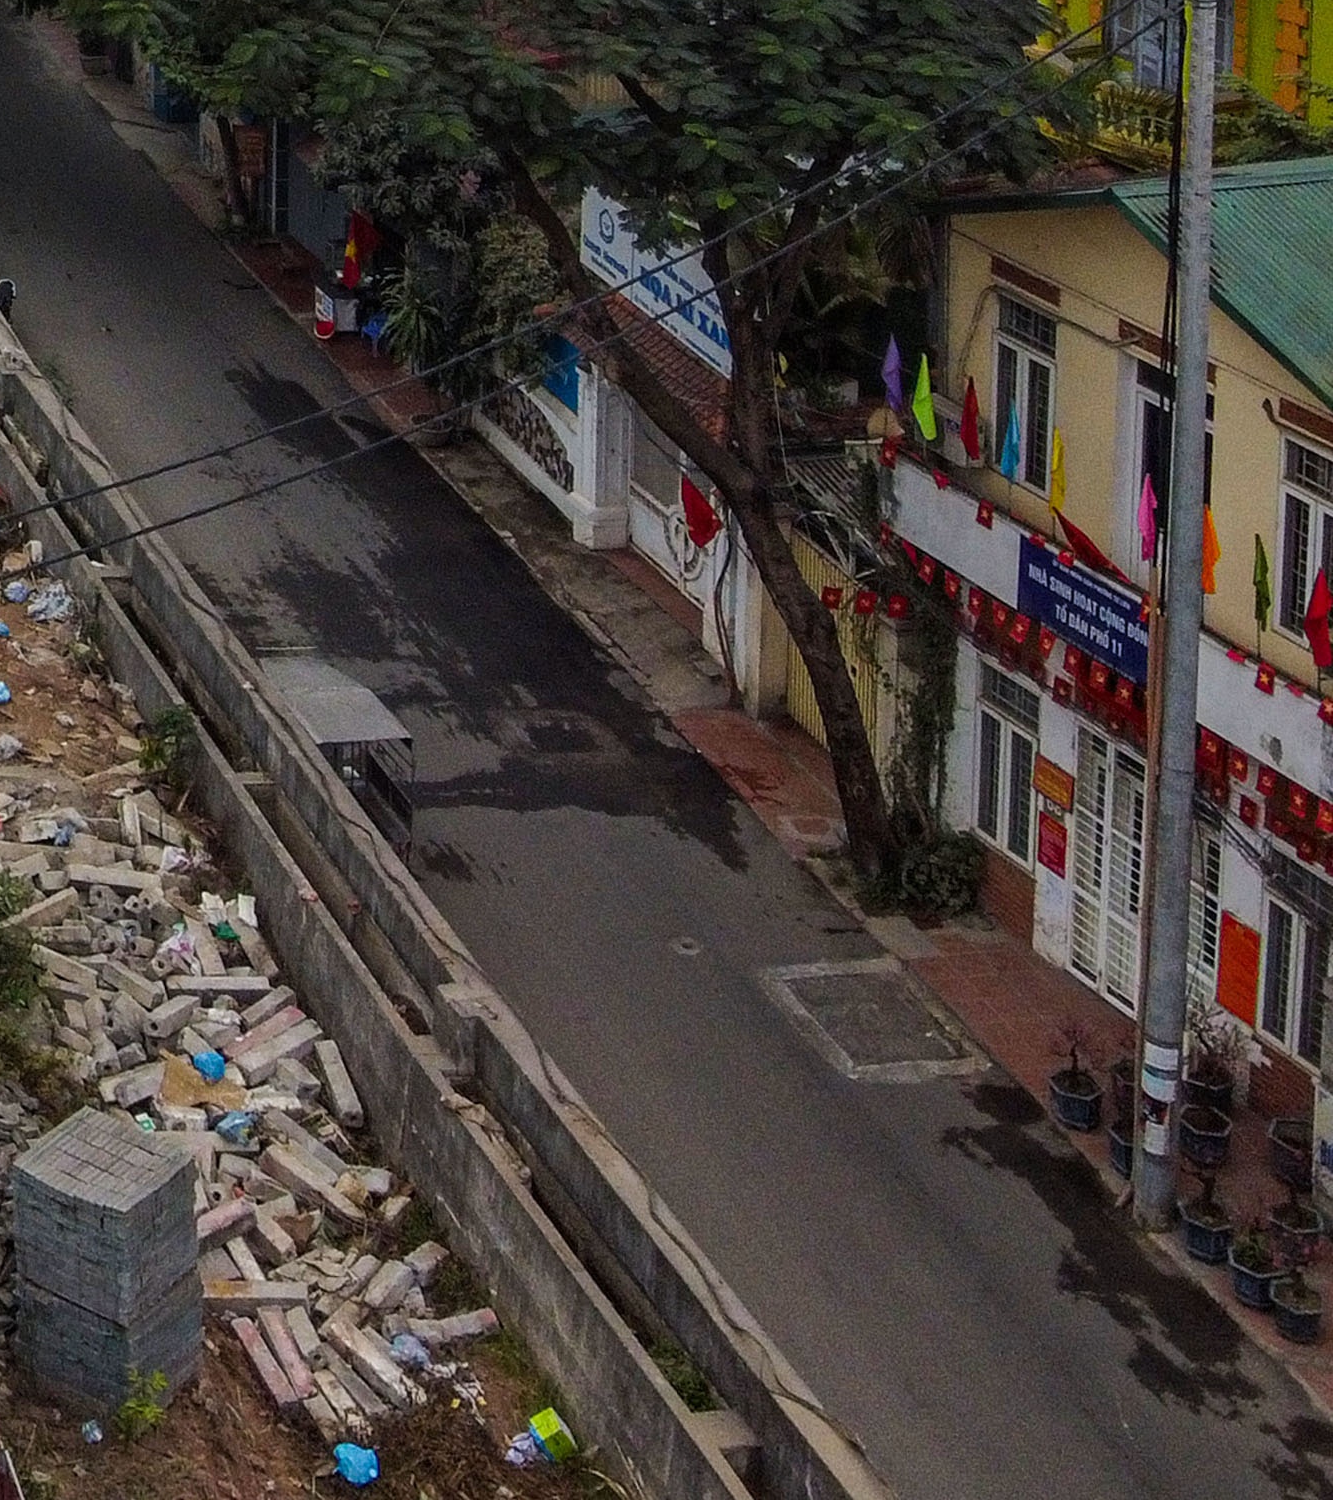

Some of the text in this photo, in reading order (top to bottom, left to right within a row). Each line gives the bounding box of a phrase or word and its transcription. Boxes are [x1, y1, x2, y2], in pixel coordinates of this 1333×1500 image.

[1028, 562, 1048, 588] NHÀ
[1049, 575, 1072, 602] SINH
[1127, 621, 1149, 648] ĐỒN
